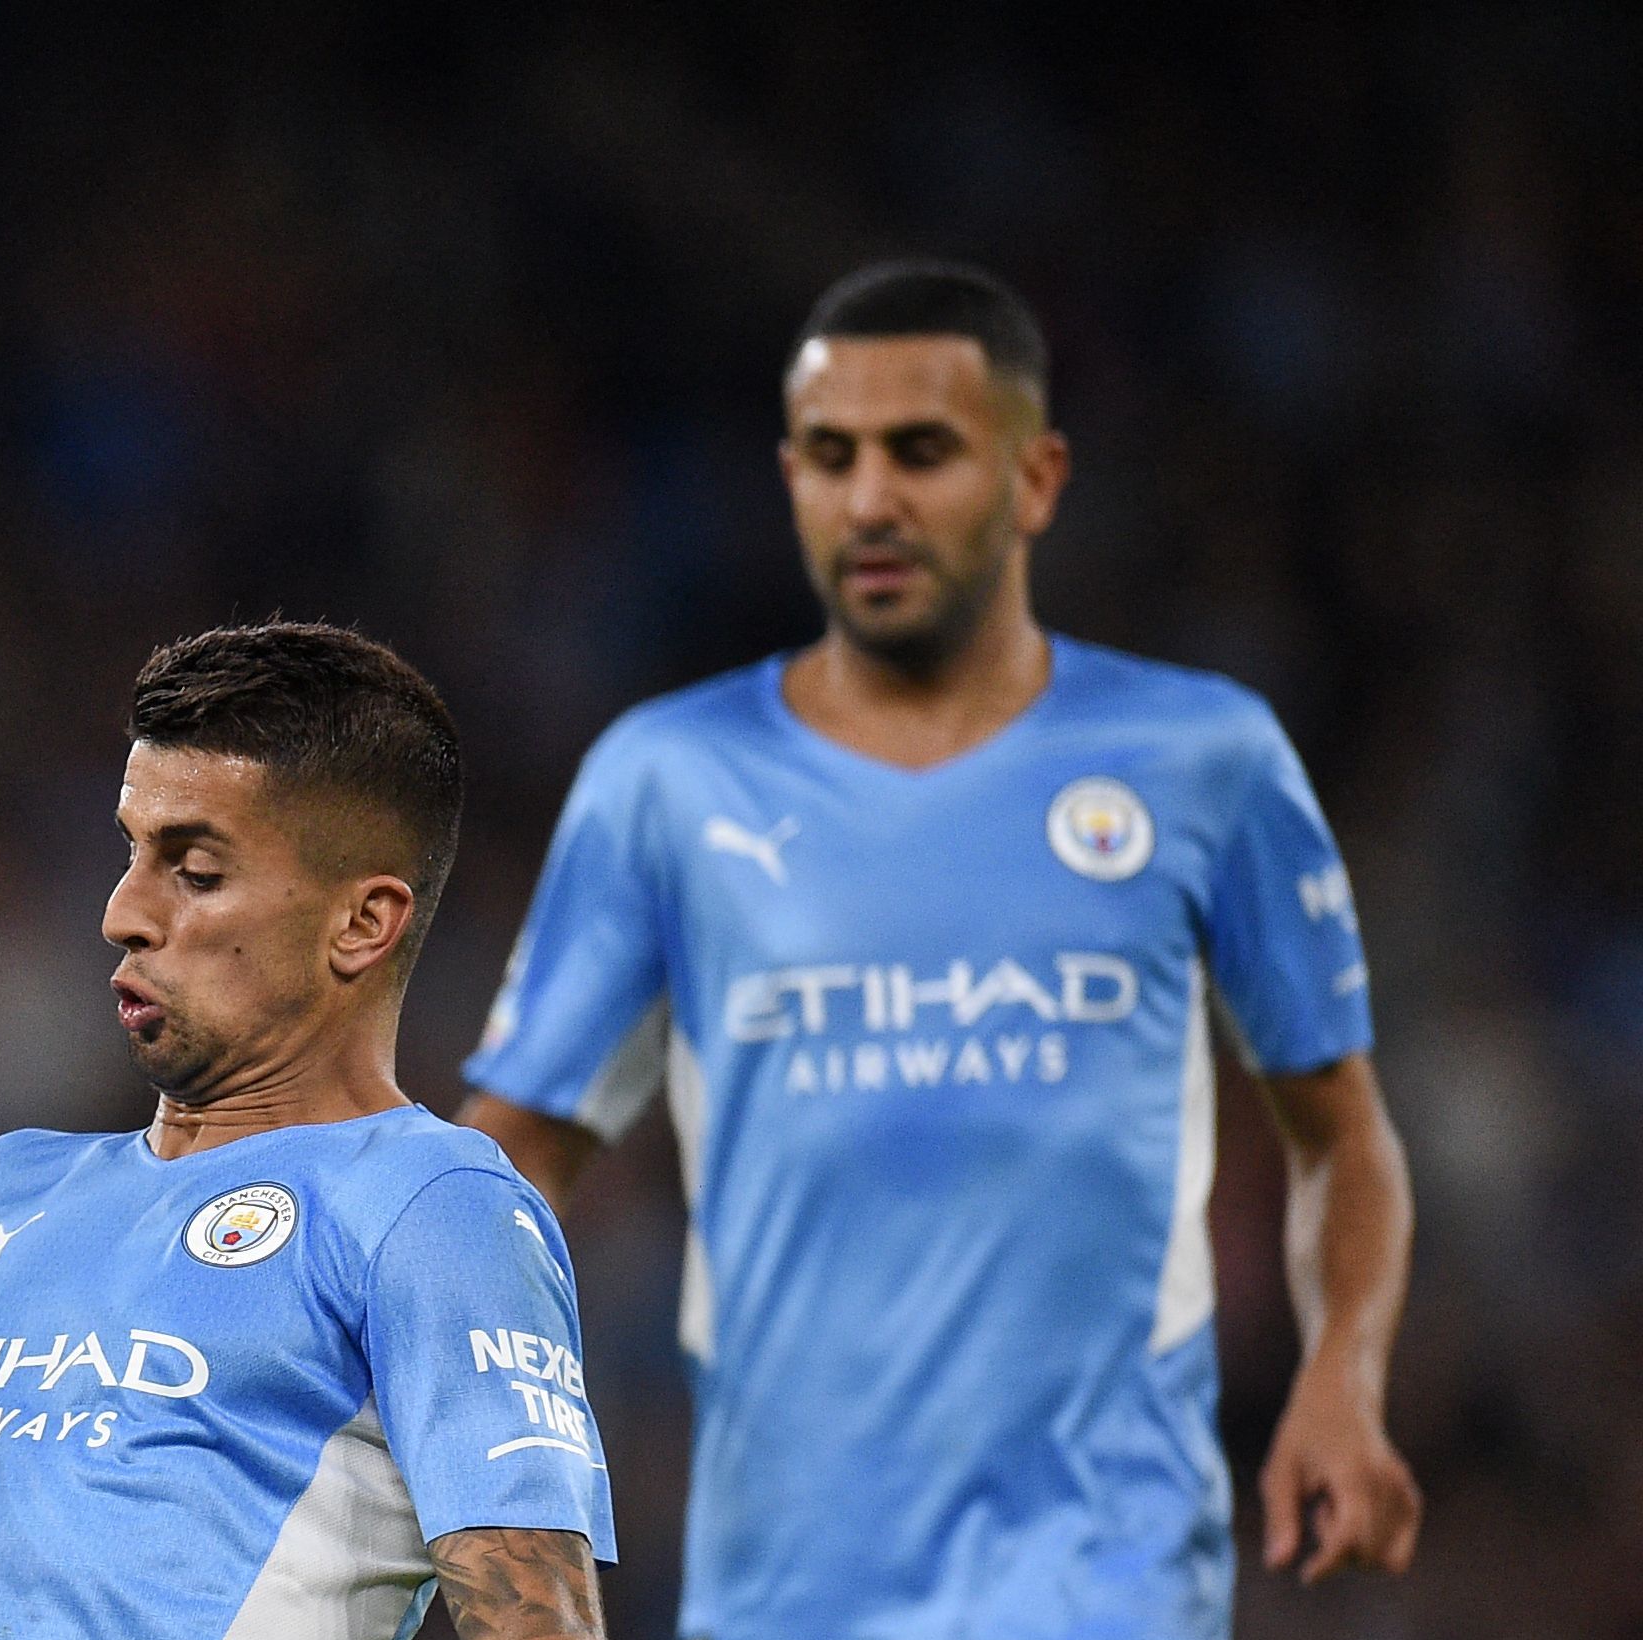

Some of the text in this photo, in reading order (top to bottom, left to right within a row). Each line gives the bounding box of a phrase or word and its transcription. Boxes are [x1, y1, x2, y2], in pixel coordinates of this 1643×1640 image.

[726, 951, 1140, 1043] ETIHAD
[786, 1033, 1068, 1095] AIRWAYS
[214, 1189, 292, 1224] MANCHESTER
[202, 1250, 234, 1263] CITY
[469, 1328, 584, 1398] NEXE
